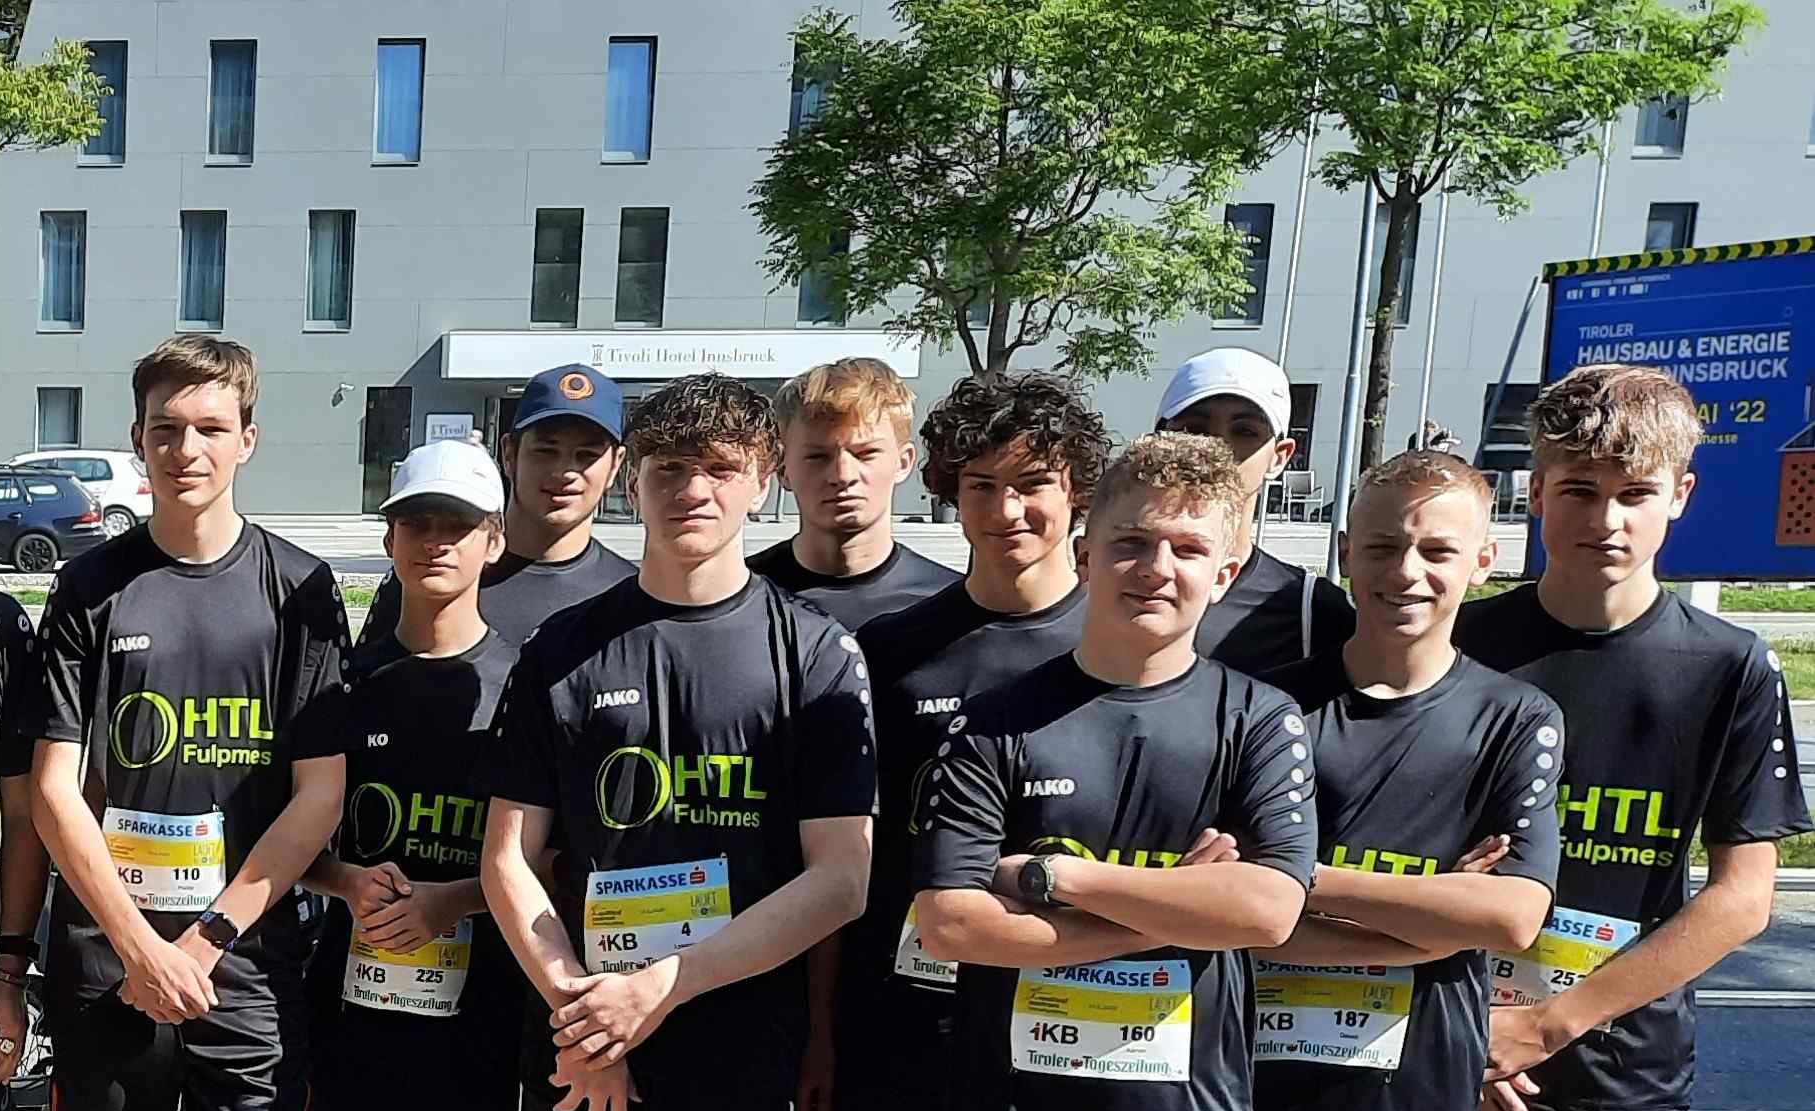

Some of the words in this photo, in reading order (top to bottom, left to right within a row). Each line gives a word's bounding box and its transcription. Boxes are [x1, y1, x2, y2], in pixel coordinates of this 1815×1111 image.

[1578, 323, 1634, 340] TIROLER
[607, 348, 652, 363] Tivoli
[656, 348, 696, 363] Hotel
[701, 347, 777, 363] Innsbruck
[1577, 339, 1674, 364] HAUSBAU
[1676, 337, 1693, 359] &
[1696, 331, 1791, 357] ENERGIE
[1696, 401, 1719, 425] AI
[112, 634, 151, 653] JAKO
[593, 689, 640, 709] JAKO
[915, 697, 962, 715] JAKO
[183, 697, 274, 740] HTL
[367, 733, 389, 748] KO
[182, 744, 272, 768] Fulpmes
[674, 754, 768, 800] HTL
[1022, 778, 1075, 798] JAKO
[1558, 784, 1681, 839] HTL
[117, 818, 194, 837] SPARKASSE
[117, 866, 144, 885] KB
[173, 867, 201, 881] 110
[595, 872, 688, 895] SPARKASSE
[681, 921, 692, 937] 4
[597, 932, 639, 952] iKB
[415, 968, 445, 984] 225
[911, 957, 948, 976] Tiroler
[1042, 967, 1151, 988] SPARKASSE
[387, 992, 453, 1012] Tageszeitung
[1258, 1012, 1295, 1031] KB
[1333, 1010, 1371, 1028] 187
[1028, 1022, 1079, 1045] iKB
[1119, 1025, 1155, 1042] 160
[1026, 1049, 1071, 1069] Tiroler
[1082, 1055, 1170, 1077] Tageszeitung
